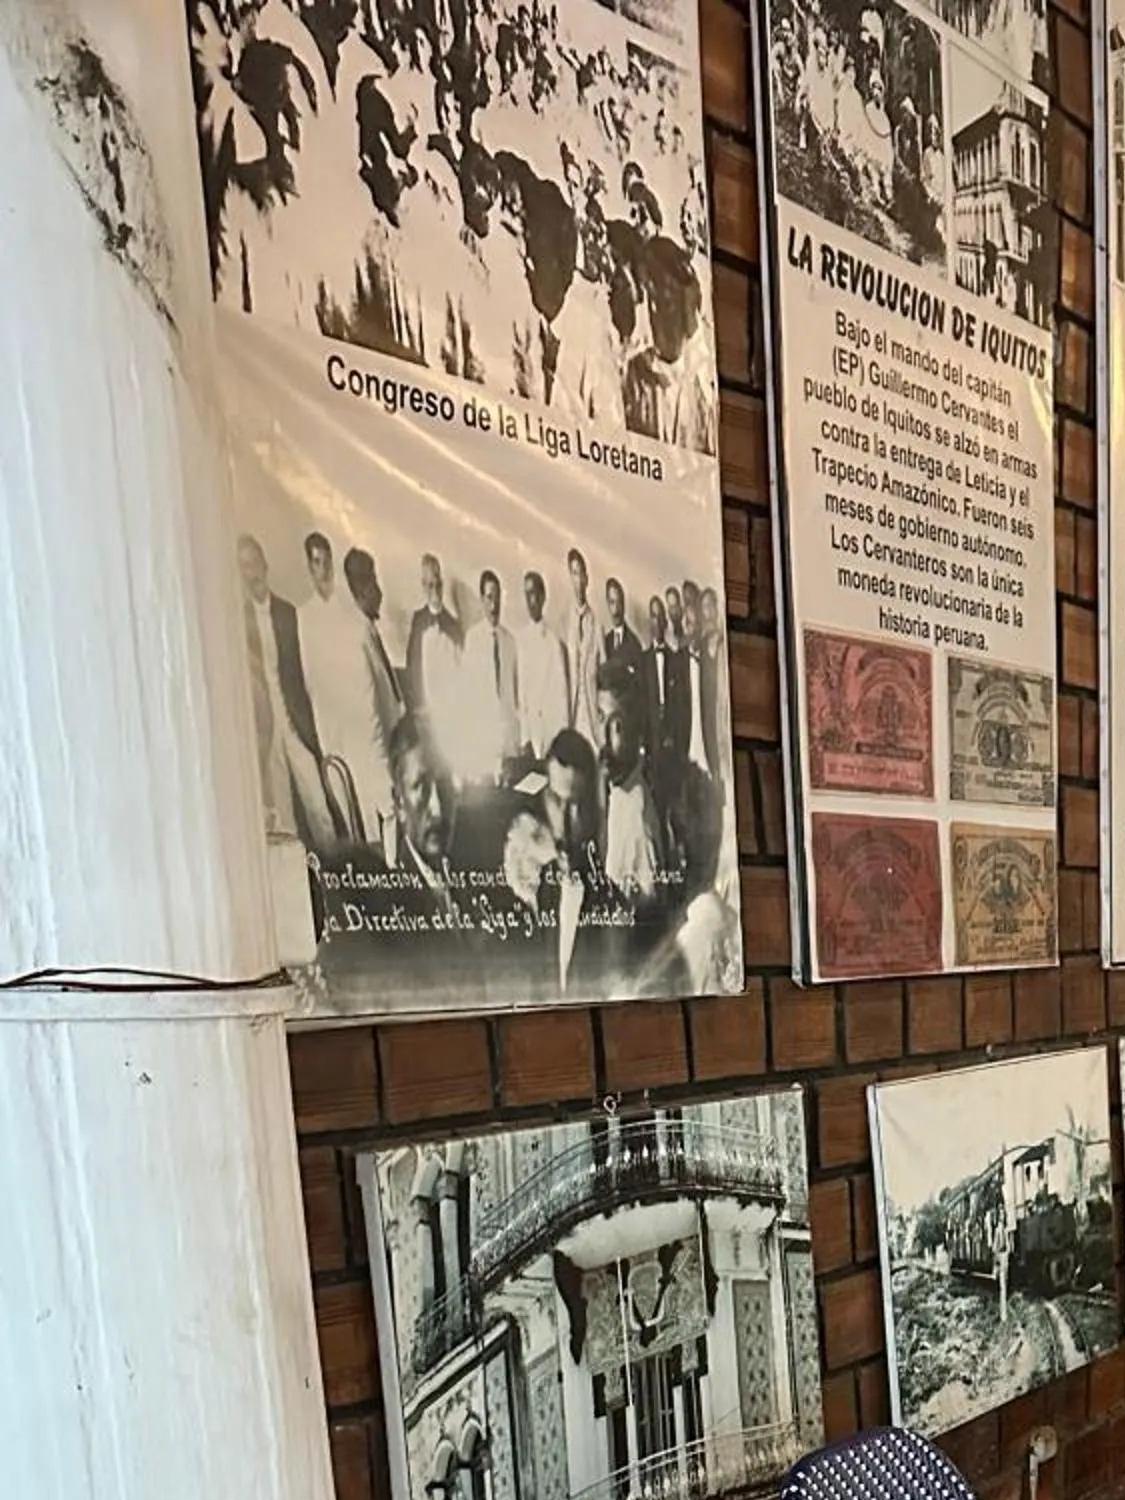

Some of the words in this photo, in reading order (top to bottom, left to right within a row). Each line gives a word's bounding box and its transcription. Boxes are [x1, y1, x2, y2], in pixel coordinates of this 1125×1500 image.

[787, 226, 813, 274] LA
[820, 243, 945, 334] REVOLUCION
[951, 306, 976, 348] DE
[981, 321, 1046, 380] IQUITOS
[832, 346, 865, 386] (EP)
[869, 361, 937, 409] Guillermo
[941, 391, 1005, 436] Cervantes
[1007, 420, 1019, 442] el
[835, 311, 871, 349] Bajo
[875, 331, 887, 353] el
[891, 339, 939, 376] mando
[942, 358, 963, 387] del
[966, 372, 1011, 406] capitán
[326, 354, 456, 422] Congreso
[463, 397, 491, 432] de
[499, 403, 518, 437] la
[525, 413, 571, 458] Liga
[576, 429, 663, 481] Loretana
[803, 376, 857, 413] pueblo
[861, 396, 879, 422] de
[883, 402, 931, 441] Iquitos
[935, 426, 950, 447] se
[953, 431, 980, 458] alzó
[983, 442, 998, 461] en
[1001, 451, 1037, 479] armas
[821, 419, 870, 453] contra
[874, 432, 886, 459] la
[890, 443, 942, 481] entrega
[945, 460, 961, 484] de
[965, 465, 1007, 501] Leticia
[1009, 486, 1018, 508] y
[1019, 487, 1030, 507] el
[812, 447, 877, 491] Trapecio
[881, 471, 960, 517] Amazónico.
[963, 498, 1007, 531] Fueron
[1011, 516, 1035, 540] seis
[825, 493, 874, 524] meses
[878, 504, 895, 529] de
[899, 516, 959, 548] gobierno
[962, 532, 1027, 569] autónomo.
[831, 525, 859, 554] Los
[863, 534, 947, 578] Cervanteros
[951, 561, 974, 583] son
[977, 565, 989, 589] la
[992, 571, 1024, 598] única
[837, 567, 896, 598] moneda
[899, 581, 993, 622] revolucionaria
[995, 602, 1010, 625] de
[1013, 605, 1023, 628] la
[879, 605, 930, 639] historia
[934, 624, 989, 652] peruana.
